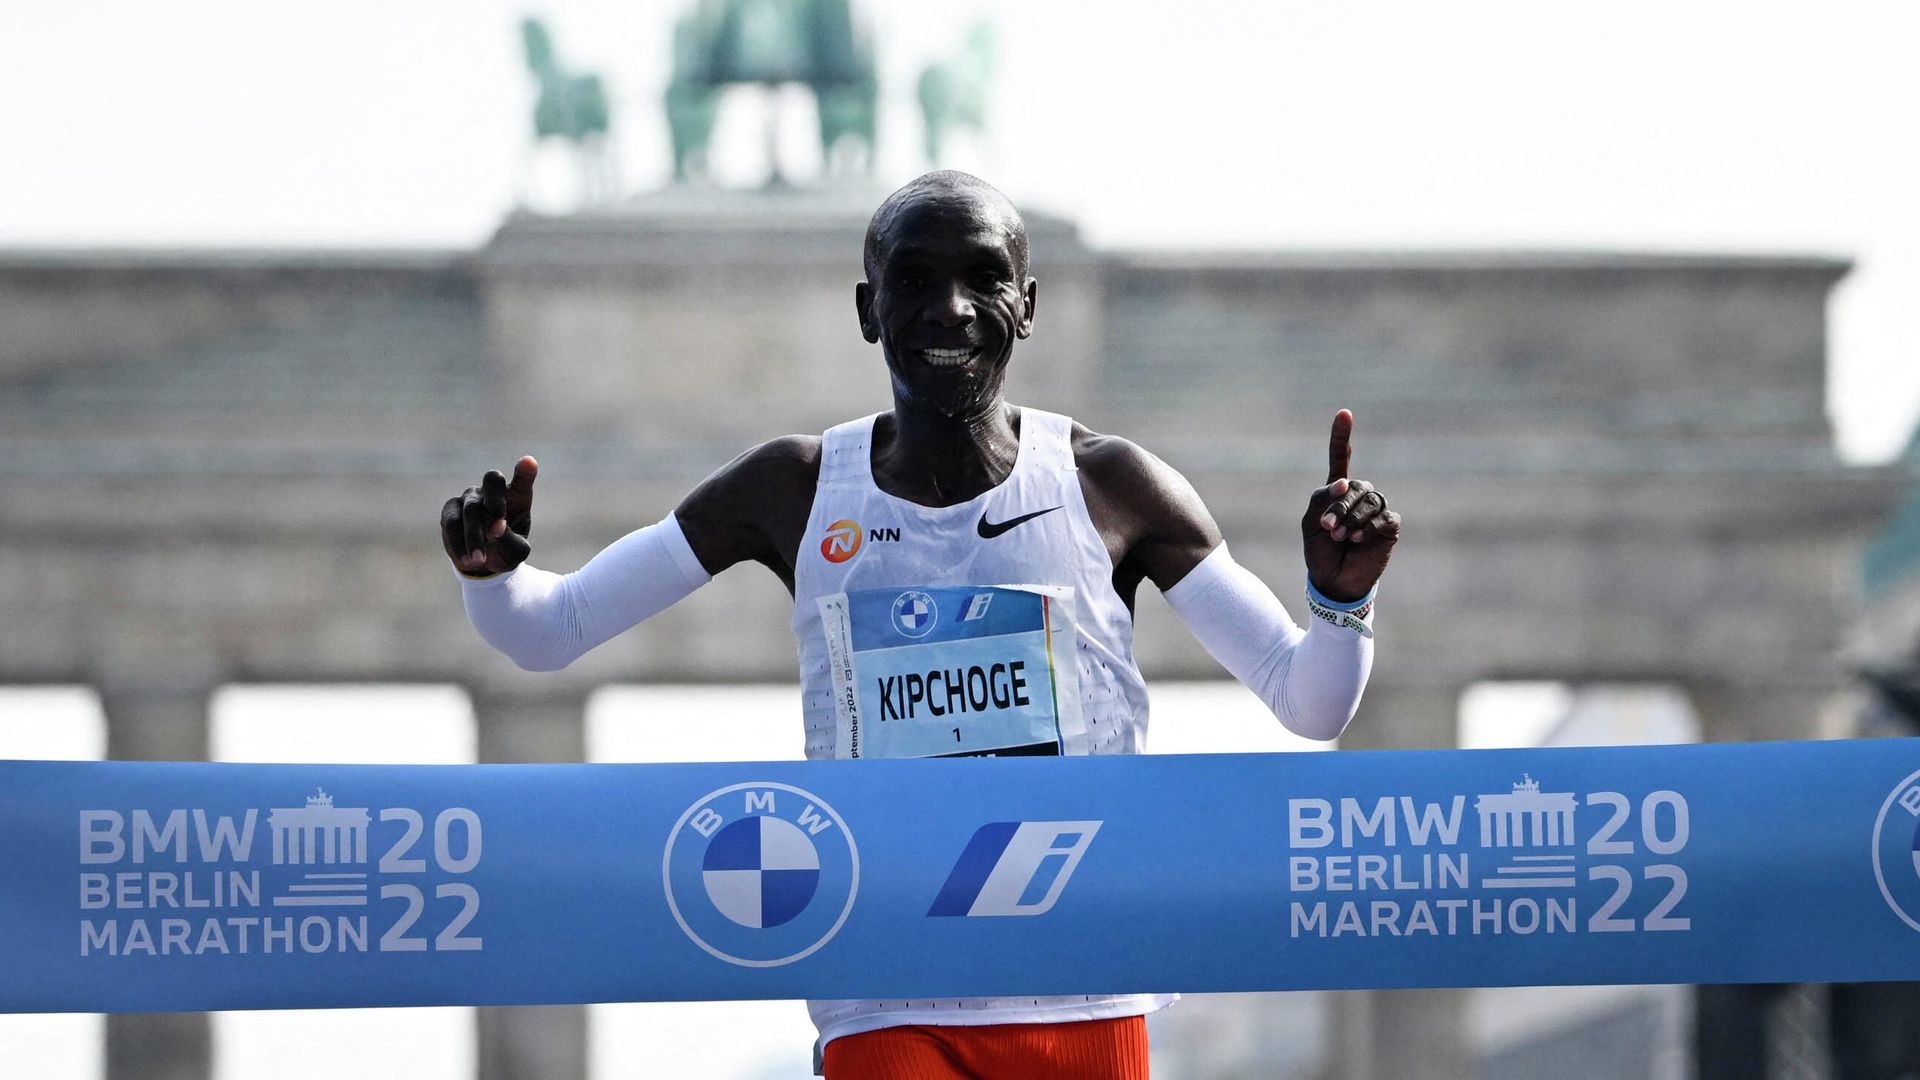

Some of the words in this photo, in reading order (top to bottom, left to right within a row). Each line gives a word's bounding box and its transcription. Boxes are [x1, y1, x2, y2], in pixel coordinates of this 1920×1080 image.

[870, 528, 900, 541] NN
[897, 593, 930, 607] BMW
[847, 686, 857, 713] 2022
[878, 661, 1029, 721] KIPCHOGE
[952, 728, 961, 742] 1
[79, 808, 258, 864] BMW
[690, 791, 832, 838] BMW
[1288, 795, 1465, 849] BMW
[1586, 790, 1690, 855] 20
[379, 807, 483, 873] 20
[80, 870, 260, 909] BERLIN
[1289, 853, 1469, 892] BERLIN
[379, 883, 483, 952] 22
[1290, 897, 1576, 938] MARATHON
[1587, 864, 1691, 933] 22
[80, 915, 368, 956] MARATHON
